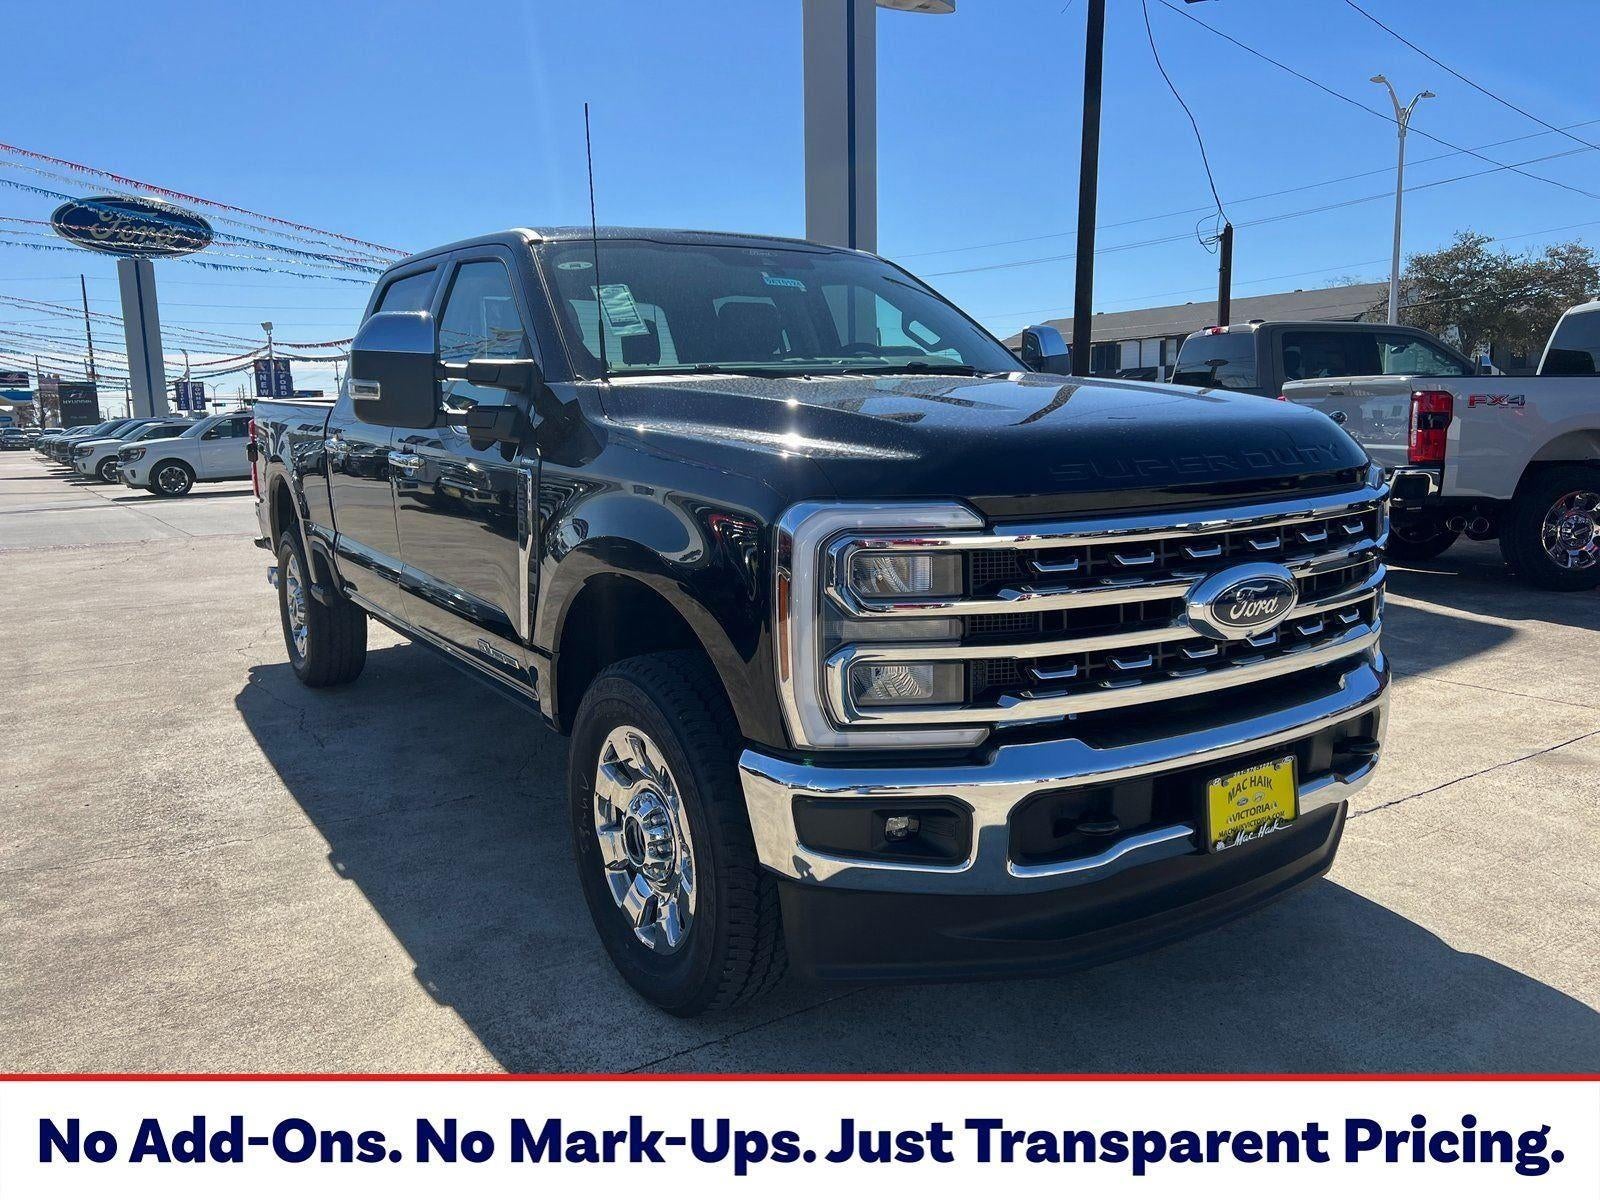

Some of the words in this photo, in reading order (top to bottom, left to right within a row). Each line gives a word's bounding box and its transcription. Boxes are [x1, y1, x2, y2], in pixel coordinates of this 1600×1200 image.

[89, 205, 178, 244] Ford
[259, 374, 269, 396] NEW
[279, 374, 288, 396] FORD
[1467, 394, 1526, 409] FX4
[1050, 454, 1240, 482] SUPER
[1244, 443, 1338, 469] DUTY
[1229, 585, 1280, 620] Ford
[1227, 777, 1248, 804] MAC
[1249, 775, 1274, 790] HAIK
[1231, 802, 1271, 823] VICTORIA
[1234, 829, 1255, 847] Mac
